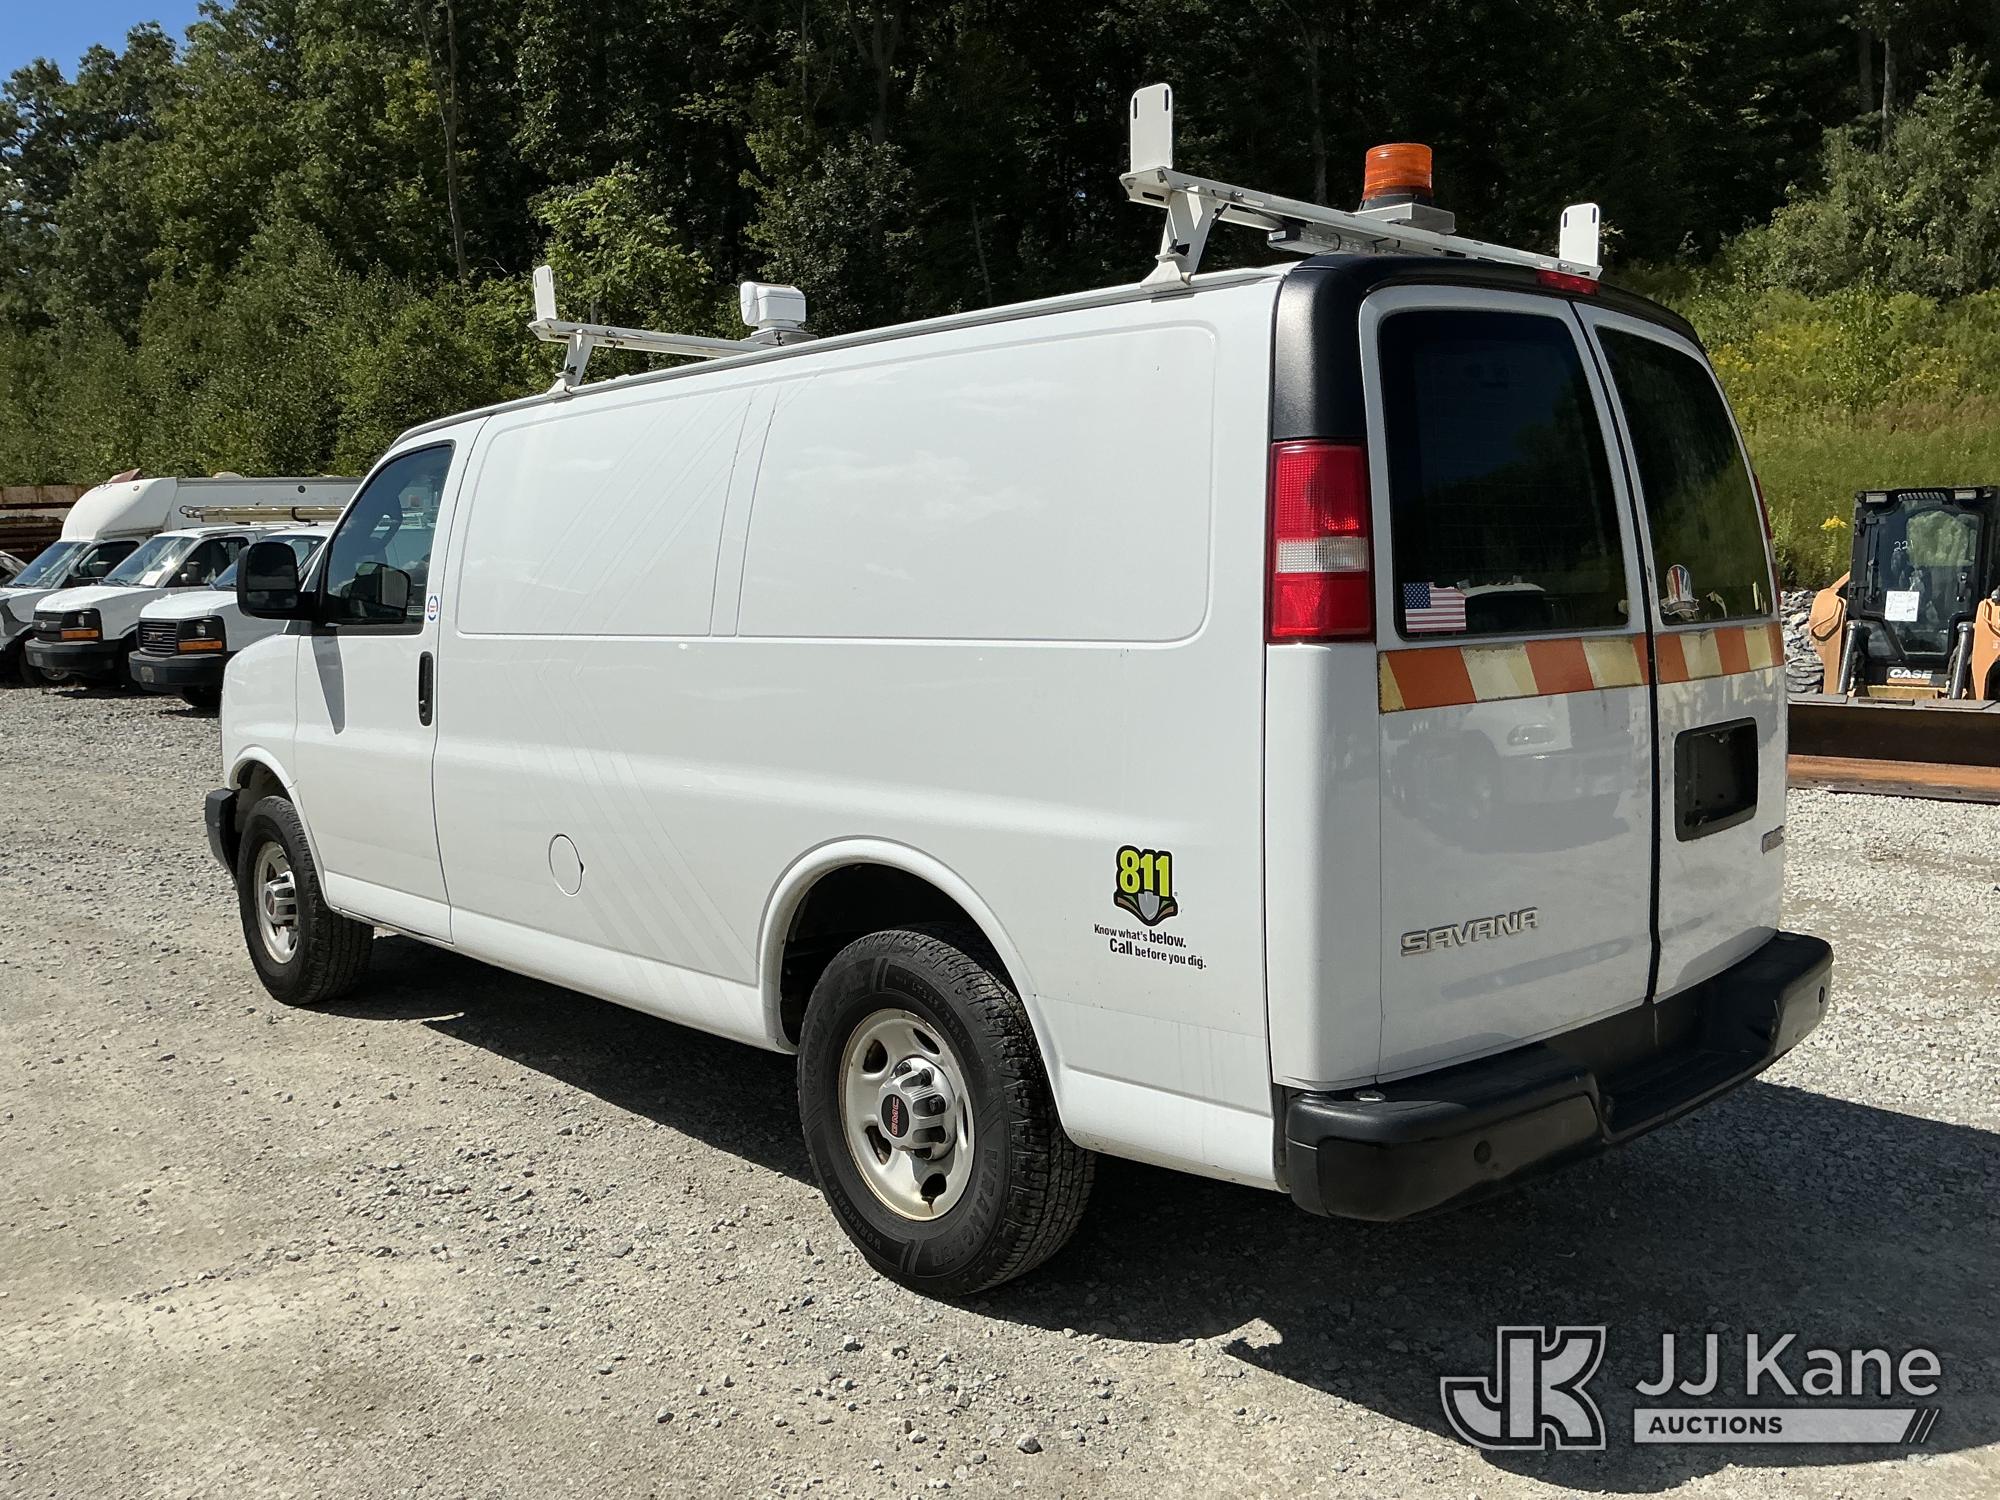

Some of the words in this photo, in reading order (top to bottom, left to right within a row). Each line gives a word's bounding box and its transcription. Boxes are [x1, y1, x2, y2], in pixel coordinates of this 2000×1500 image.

[1889, 669, 1933, 679] CASE
[1118, 848, 1170, 898] 811
[1093, 923, 1117, 937] Know
[1118, 929, 1148, 942] what's
[1149, 929, 1187, 948] below.
[1400, 906, 1539, 957] SAVANA
[1109, 938, 1133, 955] Call
[1135, 945, 1167, 961] before
[1168, 953, 1186, 965] you
[1187, 954, 1207, 970] dig.
[891, 1096, 900, 1136] GMC
